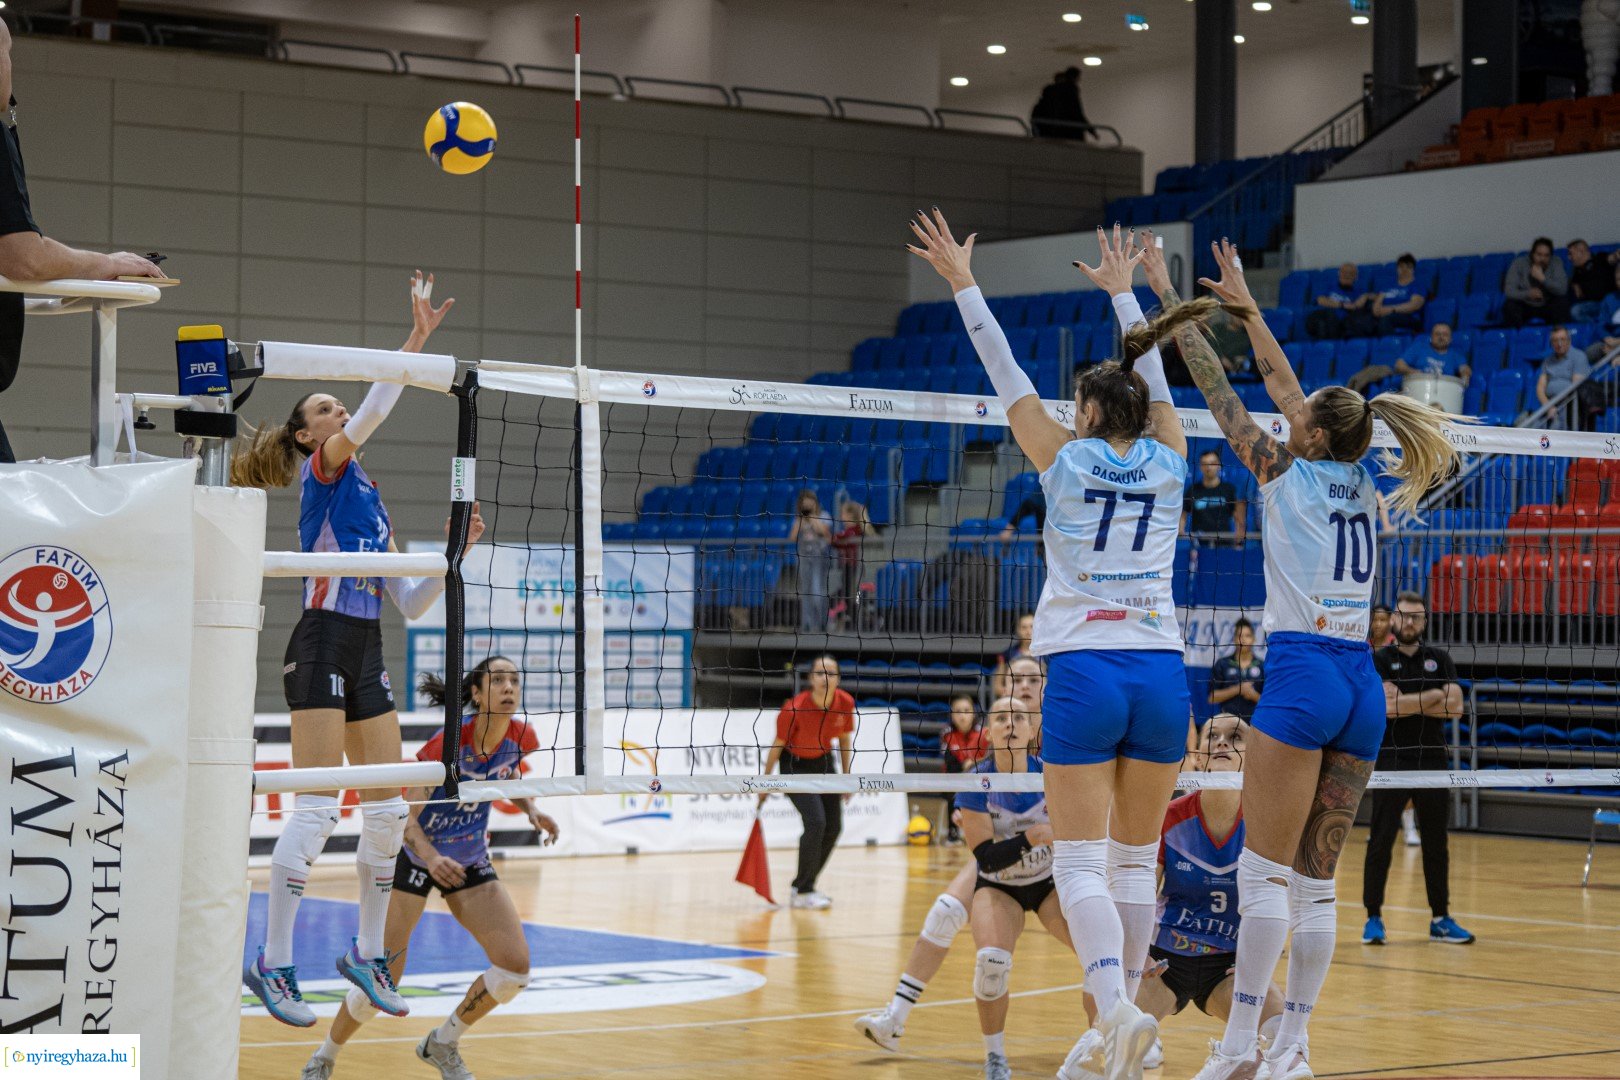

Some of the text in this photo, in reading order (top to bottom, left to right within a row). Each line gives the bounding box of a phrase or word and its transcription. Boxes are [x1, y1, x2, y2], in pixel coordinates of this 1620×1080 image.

[849, 393, 893, 411] FATUM
[1084, 488, 1157, 552] 77
[1329, 512, 1374, 584] 10
[36, 549, 98, 591] FATUM
[858, 777, 894, 790] FATUM
[408, 868, 428, 888] 13
[1210, 891, 1227, 913] 3
